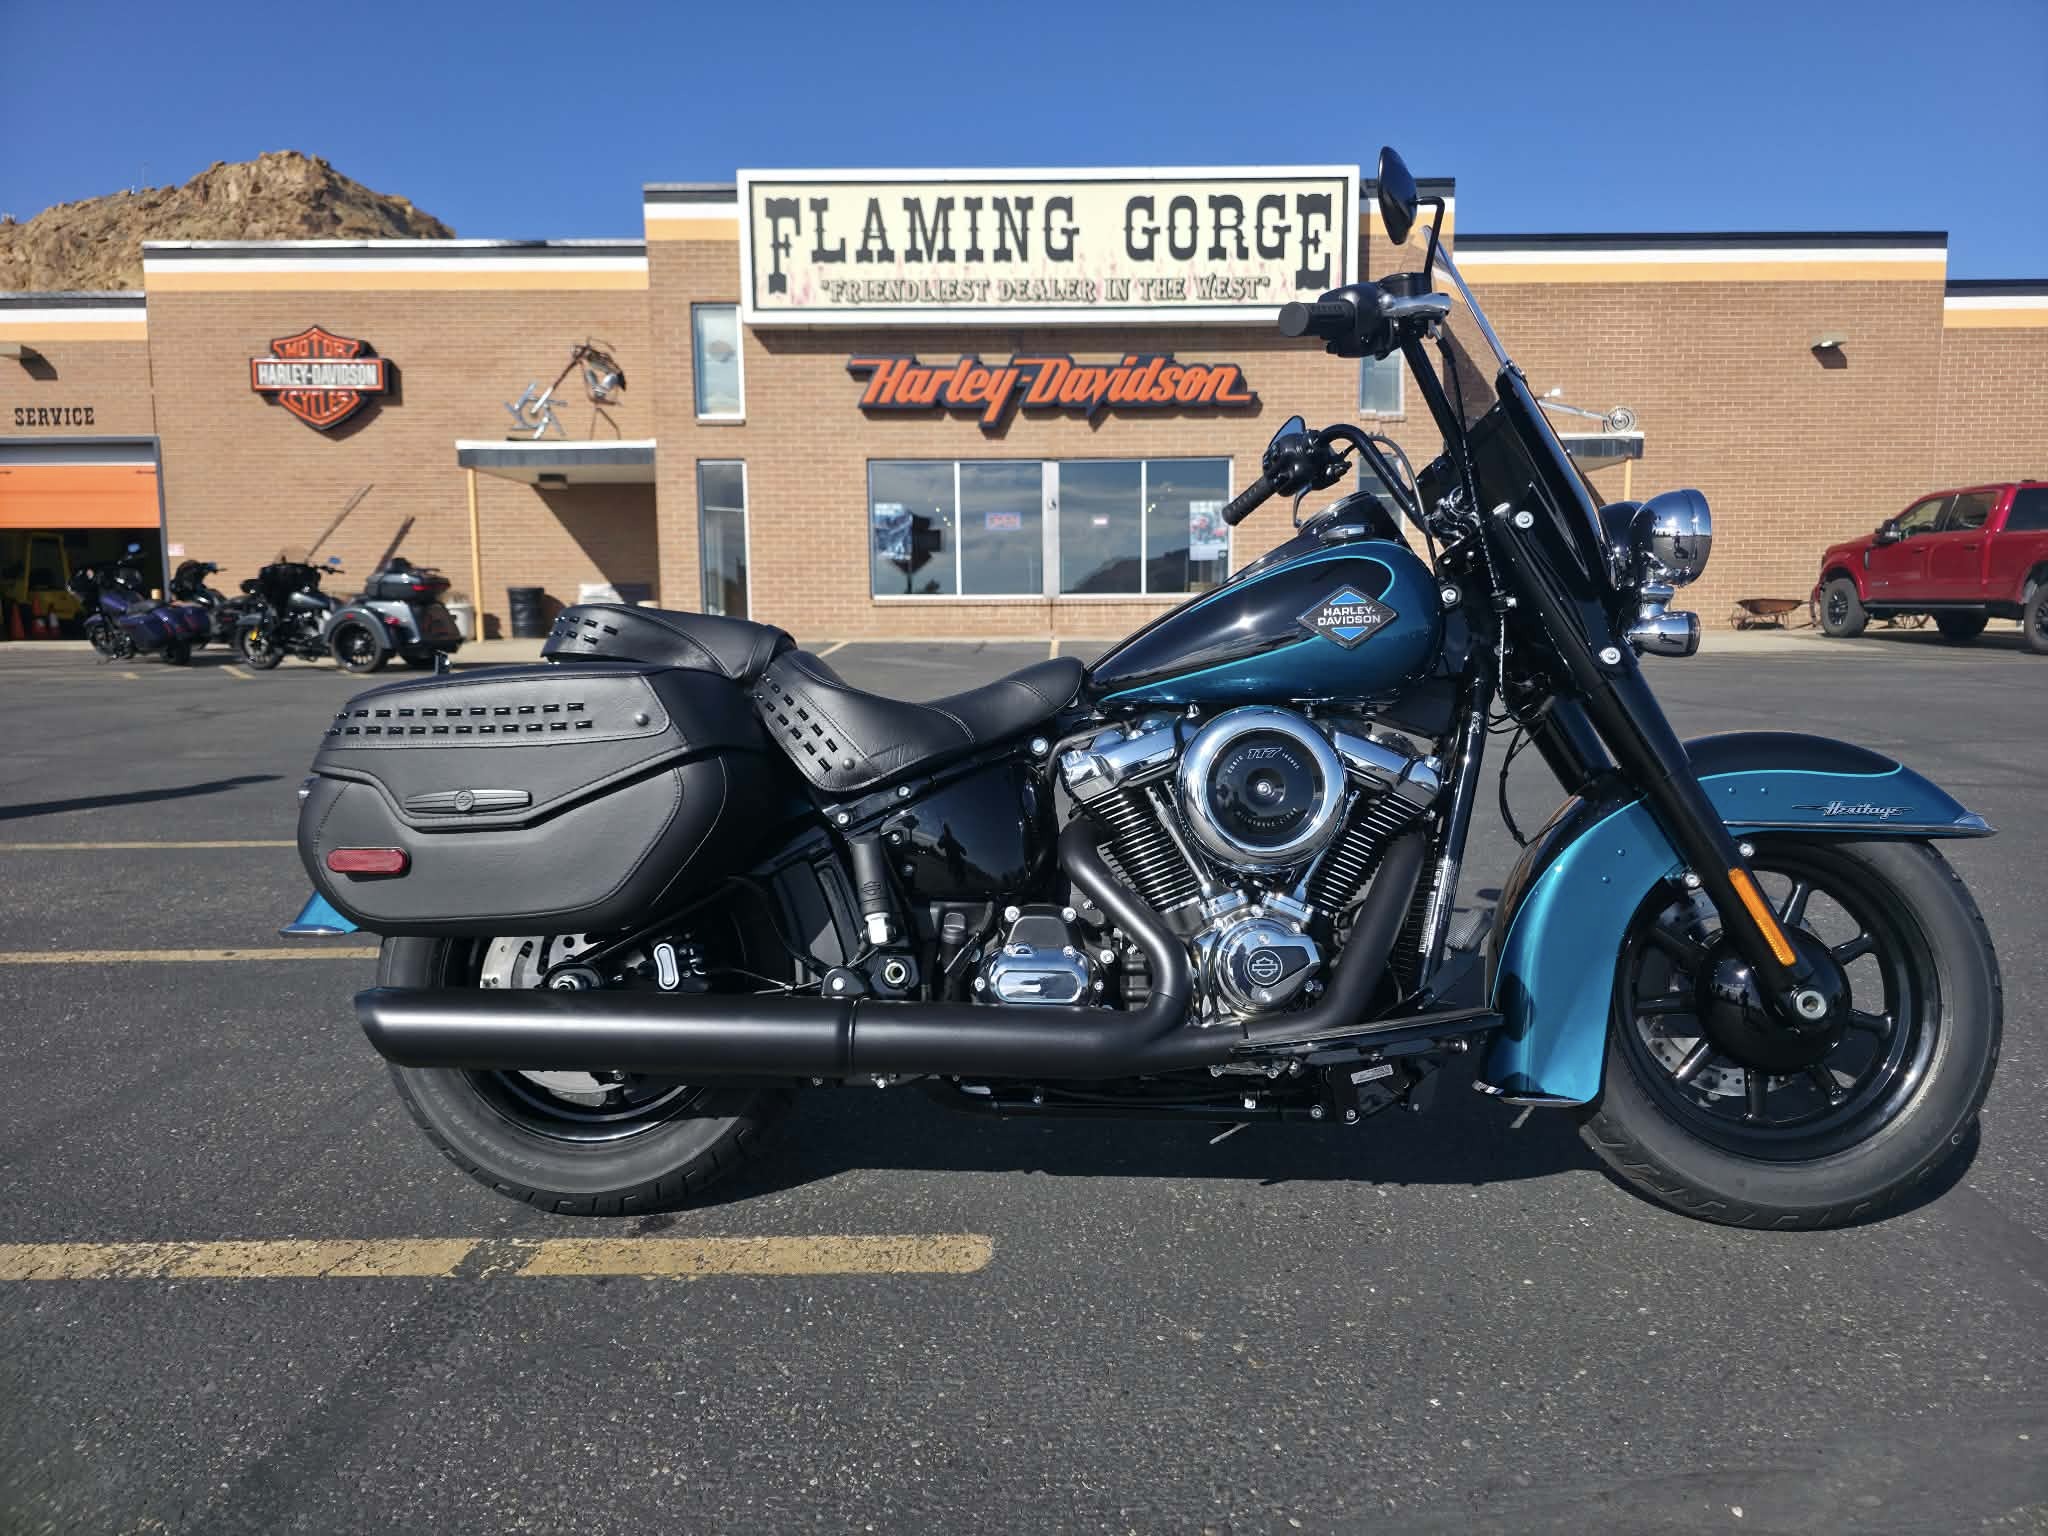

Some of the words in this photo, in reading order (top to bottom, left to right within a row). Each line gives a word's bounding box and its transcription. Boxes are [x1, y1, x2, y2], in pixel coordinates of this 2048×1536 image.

[765, 195, 1080, 295] FLAMING
[1124, 193, 1333, 291] GORGE
[999, 278, 1097, 303] DEALER
[1104, 278, 1131, 301] IN
[1137, 277, 1187, 301] THE
[283, 333, 347, 358] MOTOR
[257, 362, 378, 386] HARLEY-DAVIDSON
[851, 355, 1257, 423] Harley-Davidson
[287, 390, 351, 417] CYCLES
[14, 407, 95, 426] SERVICE
[1317, 615, 1381, 626] DAVIDSON
[1323, 605, 1376, 616] HARLEY-
[1822, 800, 1904, 820] Heritage
